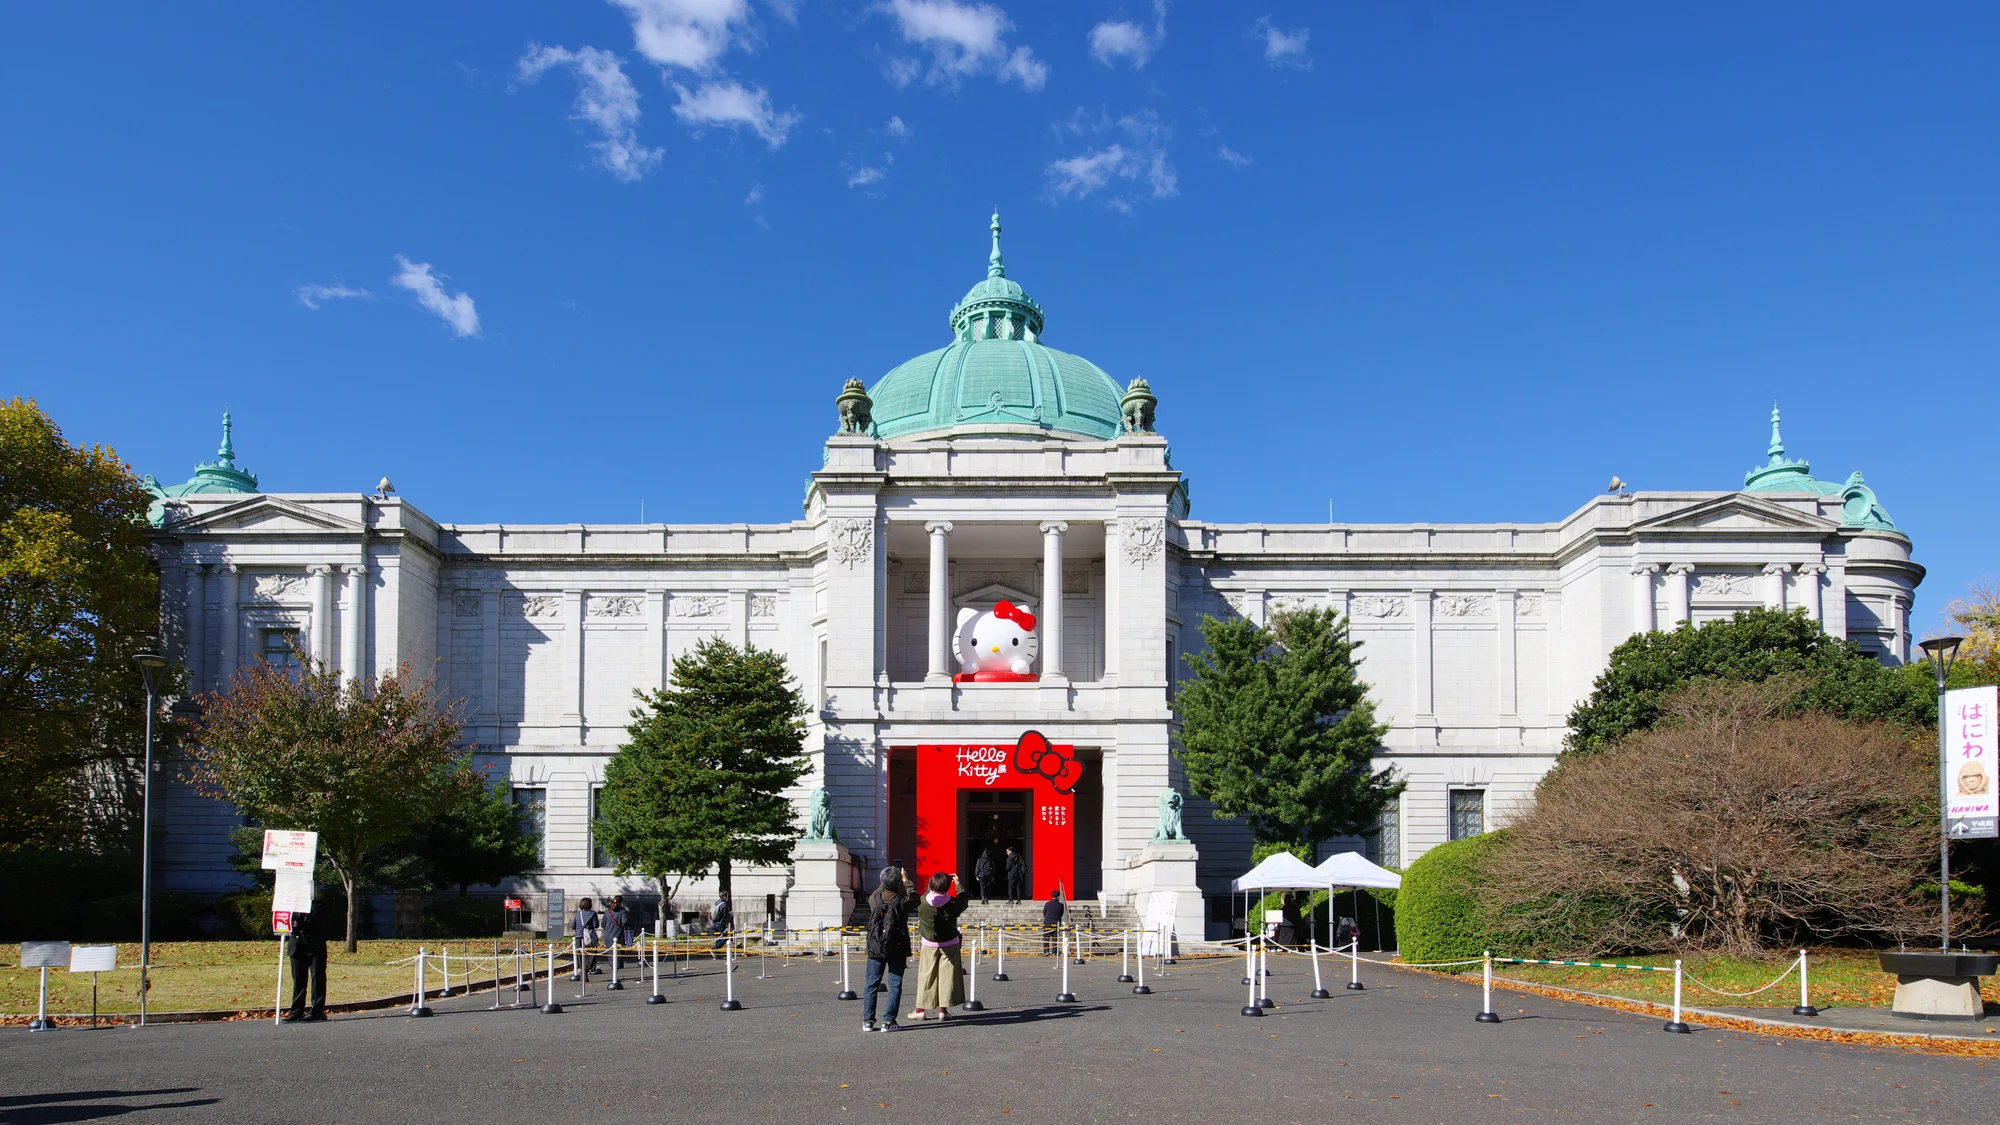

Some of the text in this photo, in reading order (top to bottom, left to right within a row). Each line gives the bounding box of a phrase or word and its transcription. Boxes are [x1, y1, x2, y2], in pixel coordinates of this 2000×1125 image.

[1962, 703, 1983, 759] はにわ
[956, 747, 1007, 762] Hello
[1951, 804, 1989, 813] HANIWA
